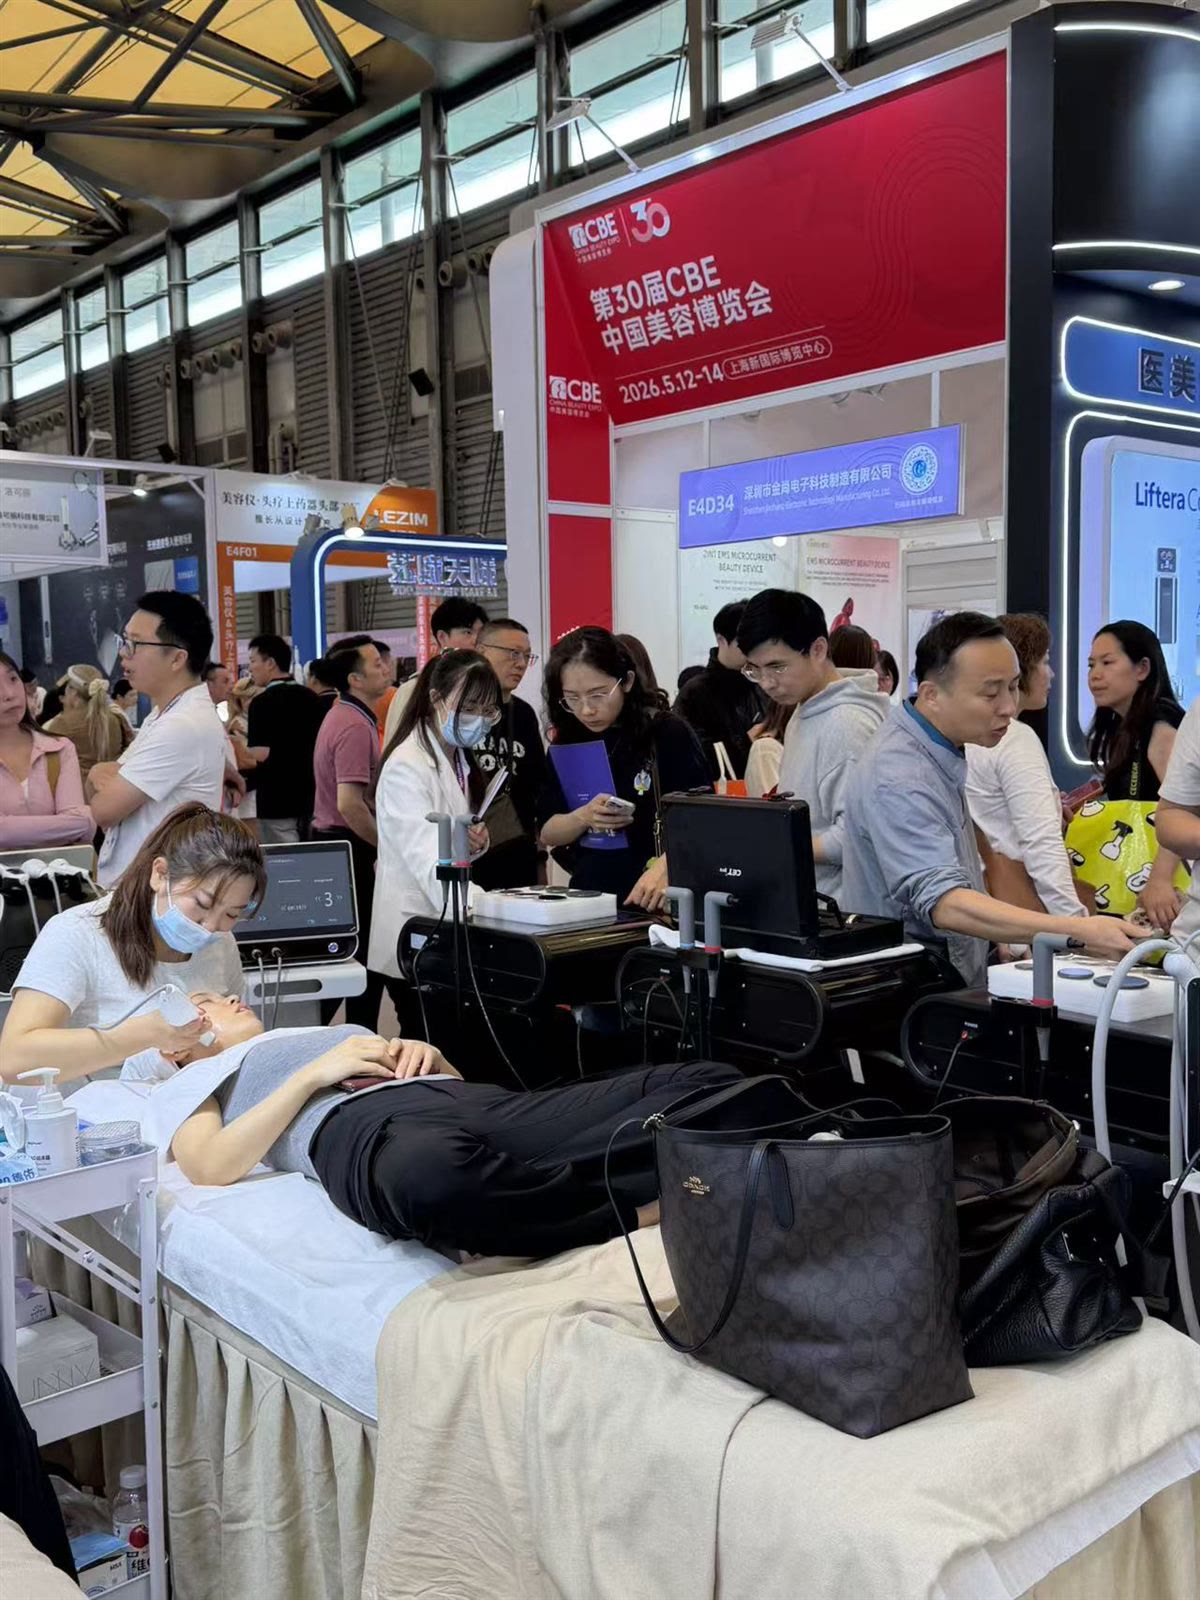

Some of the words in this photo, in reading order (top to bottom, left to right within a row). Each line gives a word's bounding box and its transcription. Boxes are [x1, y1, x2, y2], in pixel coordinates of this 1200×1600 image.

[585, 212, 619, 242] CBE
[630, 198, 671, 243] 30
[589, 255, 721, 322] 第30届CBE
[601, 281, 773, 356] 中国美容博览会
[619, 362, 724, 404] 2026.5.12-14
[730, 340, 826, 376] 上海新国际博览中心
[567, 379, 602, 404] CBE
[688, 494, 735, 517] E4D34
[1135, 481, 1185, 511] Liftera
[1187, 488, 1200, 512] C
[226, 546, 257, 557] E4F01
[731, 551, 776, 562] MICROCURRENT
[719, 562, 741, 572] BEAUTY
[743, 564, 764, 574] DEVICE
[324, 892, 333, 907] 3
